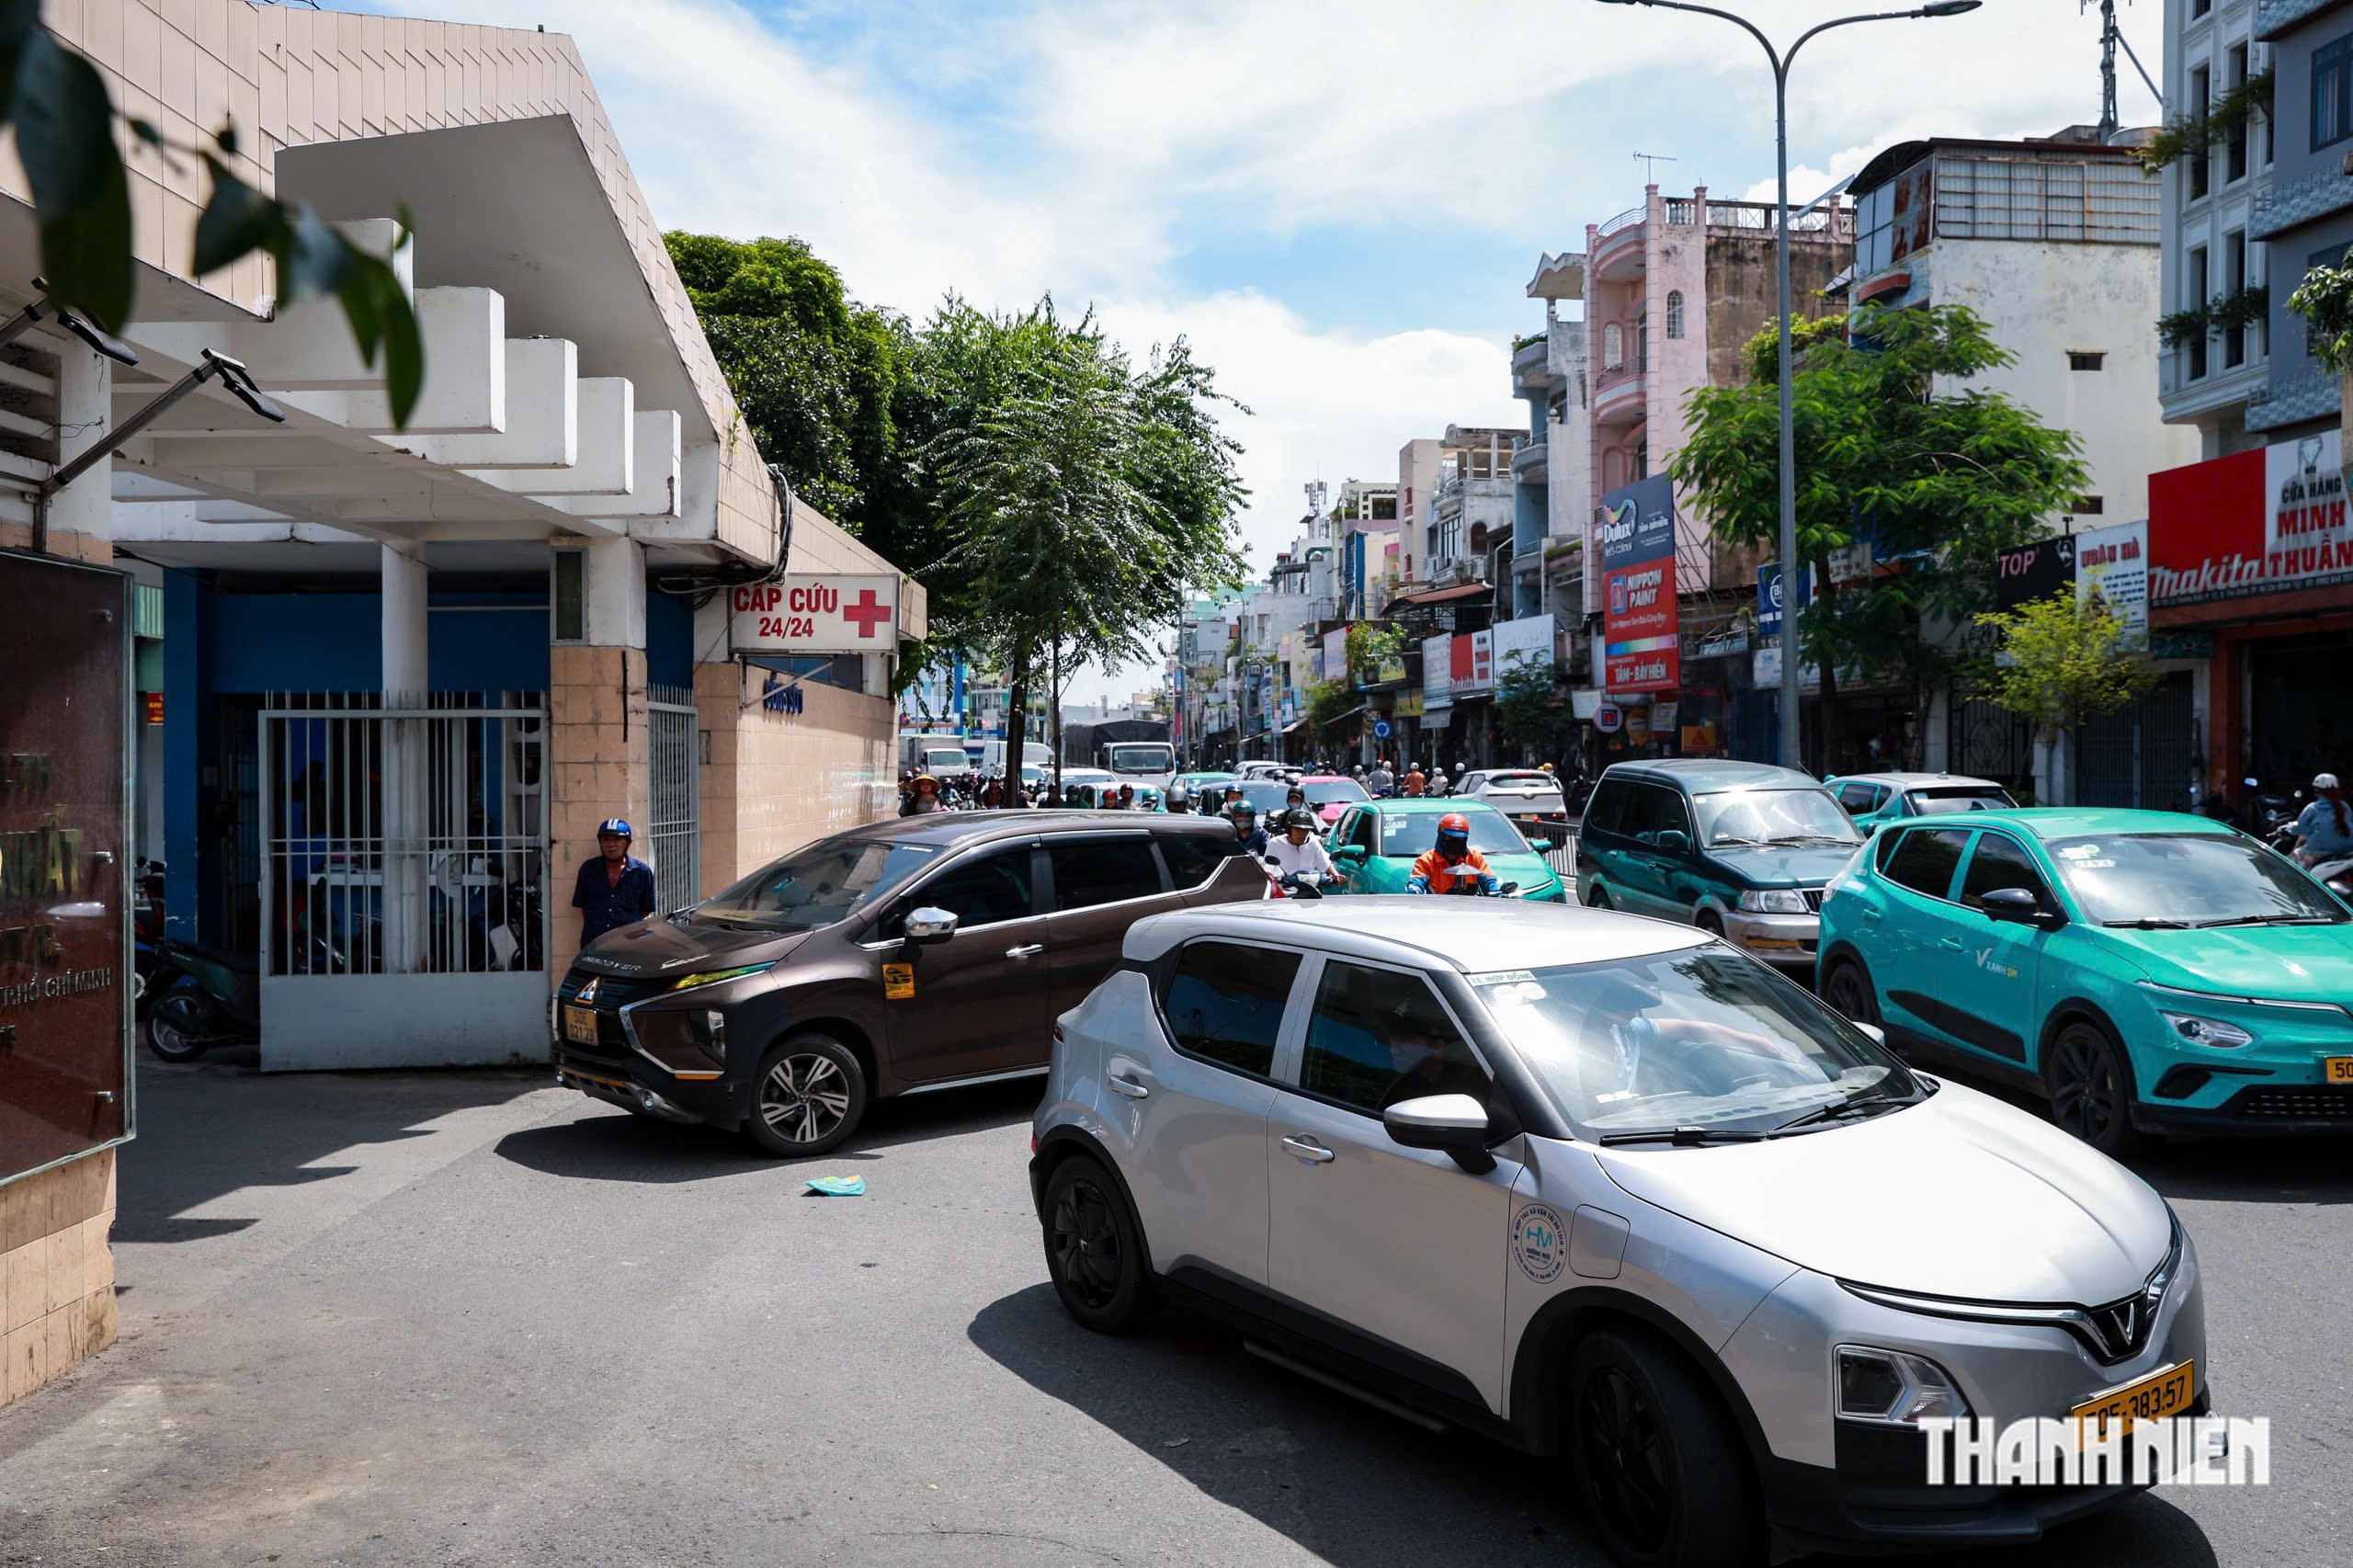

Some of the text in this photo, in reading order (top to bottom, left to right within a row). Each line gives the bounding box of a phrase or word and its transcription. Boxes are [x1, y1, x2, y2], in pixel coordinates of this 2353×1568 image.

[2309, 477, 2342, 498] HÀNG
[2277, 500, 2347, 538] MINH
[1604, 522, 1632, 544] Dulux
[2000, 550, 2036, 579] TOP
[1628, 568, 1663, 592] NIPPON
[790, 582, 838, 614] CỨU
[1630, 588, 1659, 608] PAINT
[758, 617, 814, 639] 24/24
[75, 967, 111, 993] MINH
[1471, 976, 1483, 984] XE
[1485, 973, 1505, 983] HỢP
